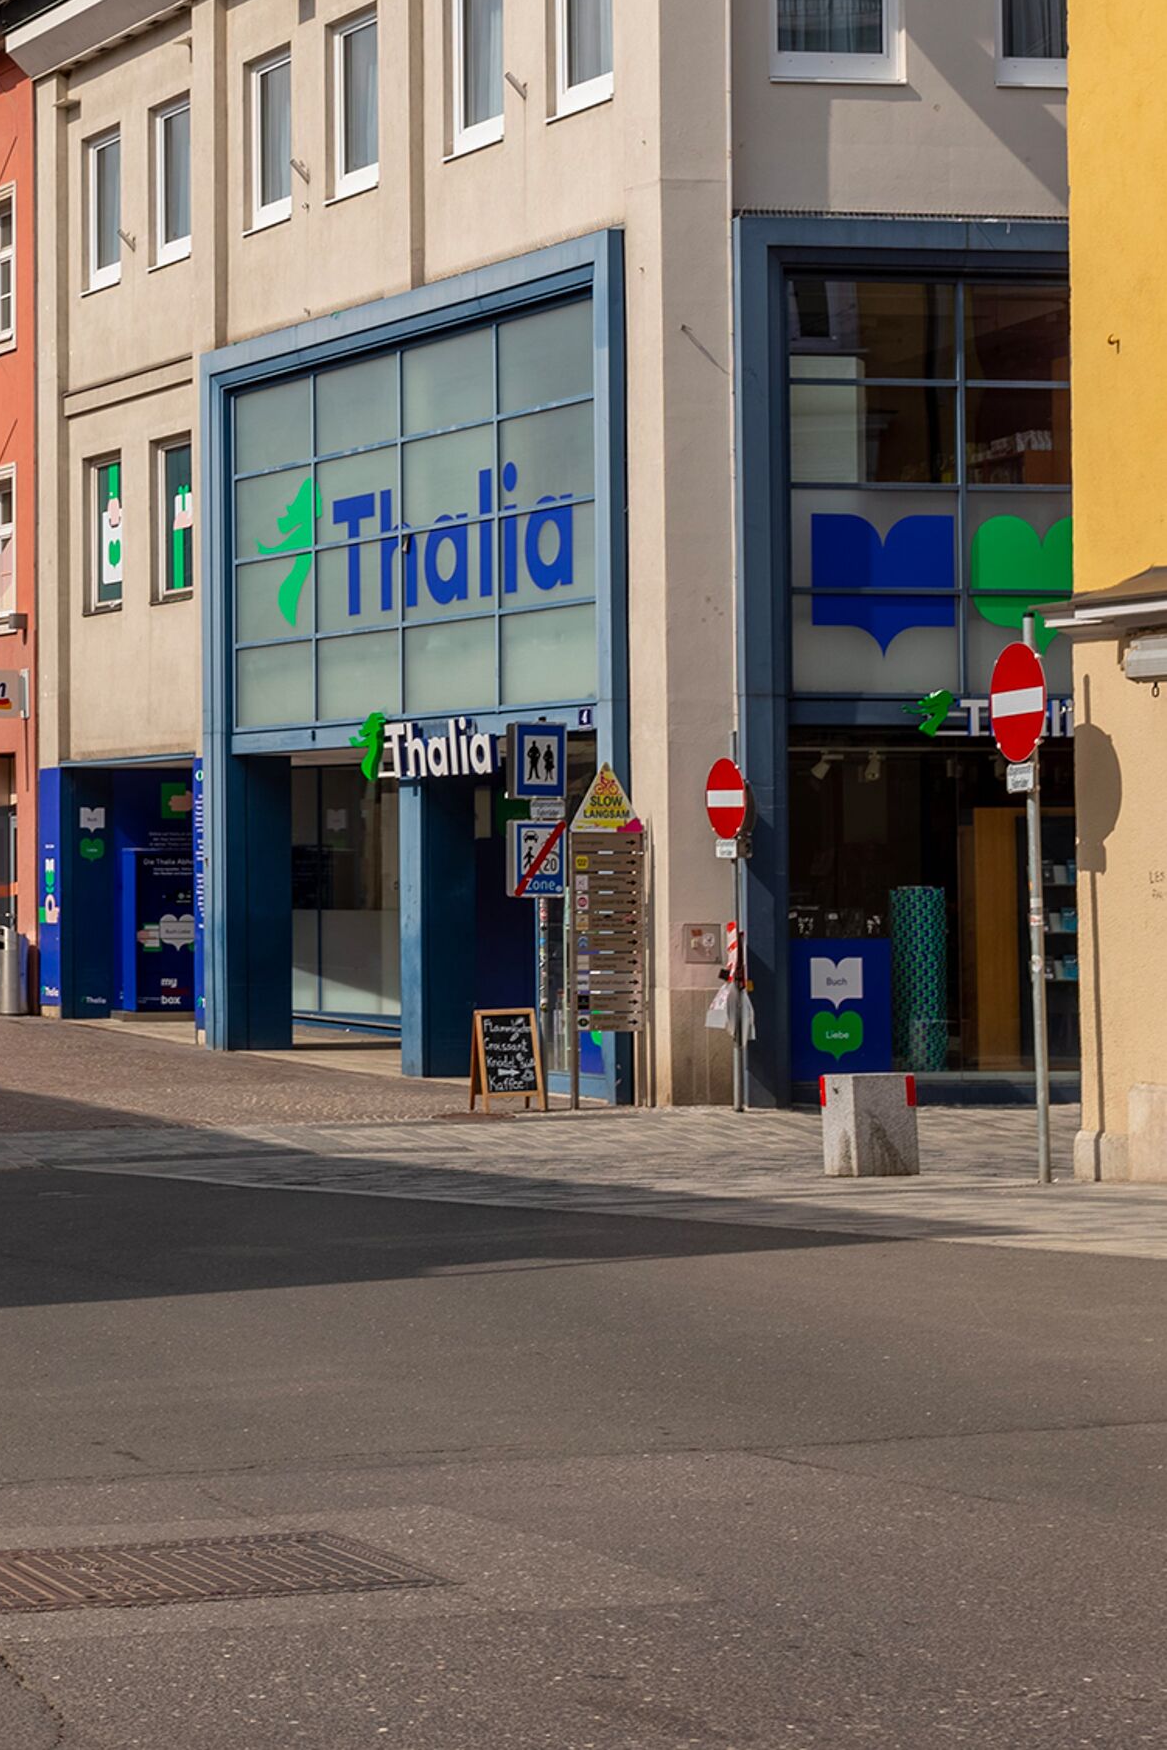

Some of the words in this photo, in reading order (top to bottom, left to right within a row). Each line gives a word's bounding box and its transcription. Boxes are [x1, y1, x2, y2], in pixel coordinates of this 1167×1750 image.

[333, 461, 573, 616] Thalia
[384, 716, 493, 778] Thalia
[590, 796, 623, 807] SLOW
[583, 809, 630, 819] LANGSAM
[543, 858, 557, 872] 20
[525, 878, 555, 891] Zone
[160, 978, 178, 989] my
[826, 977, 847, 987] Buch
[160, 995, 181, 1005] box
[826, 1030, 849, 1040] Liebe
